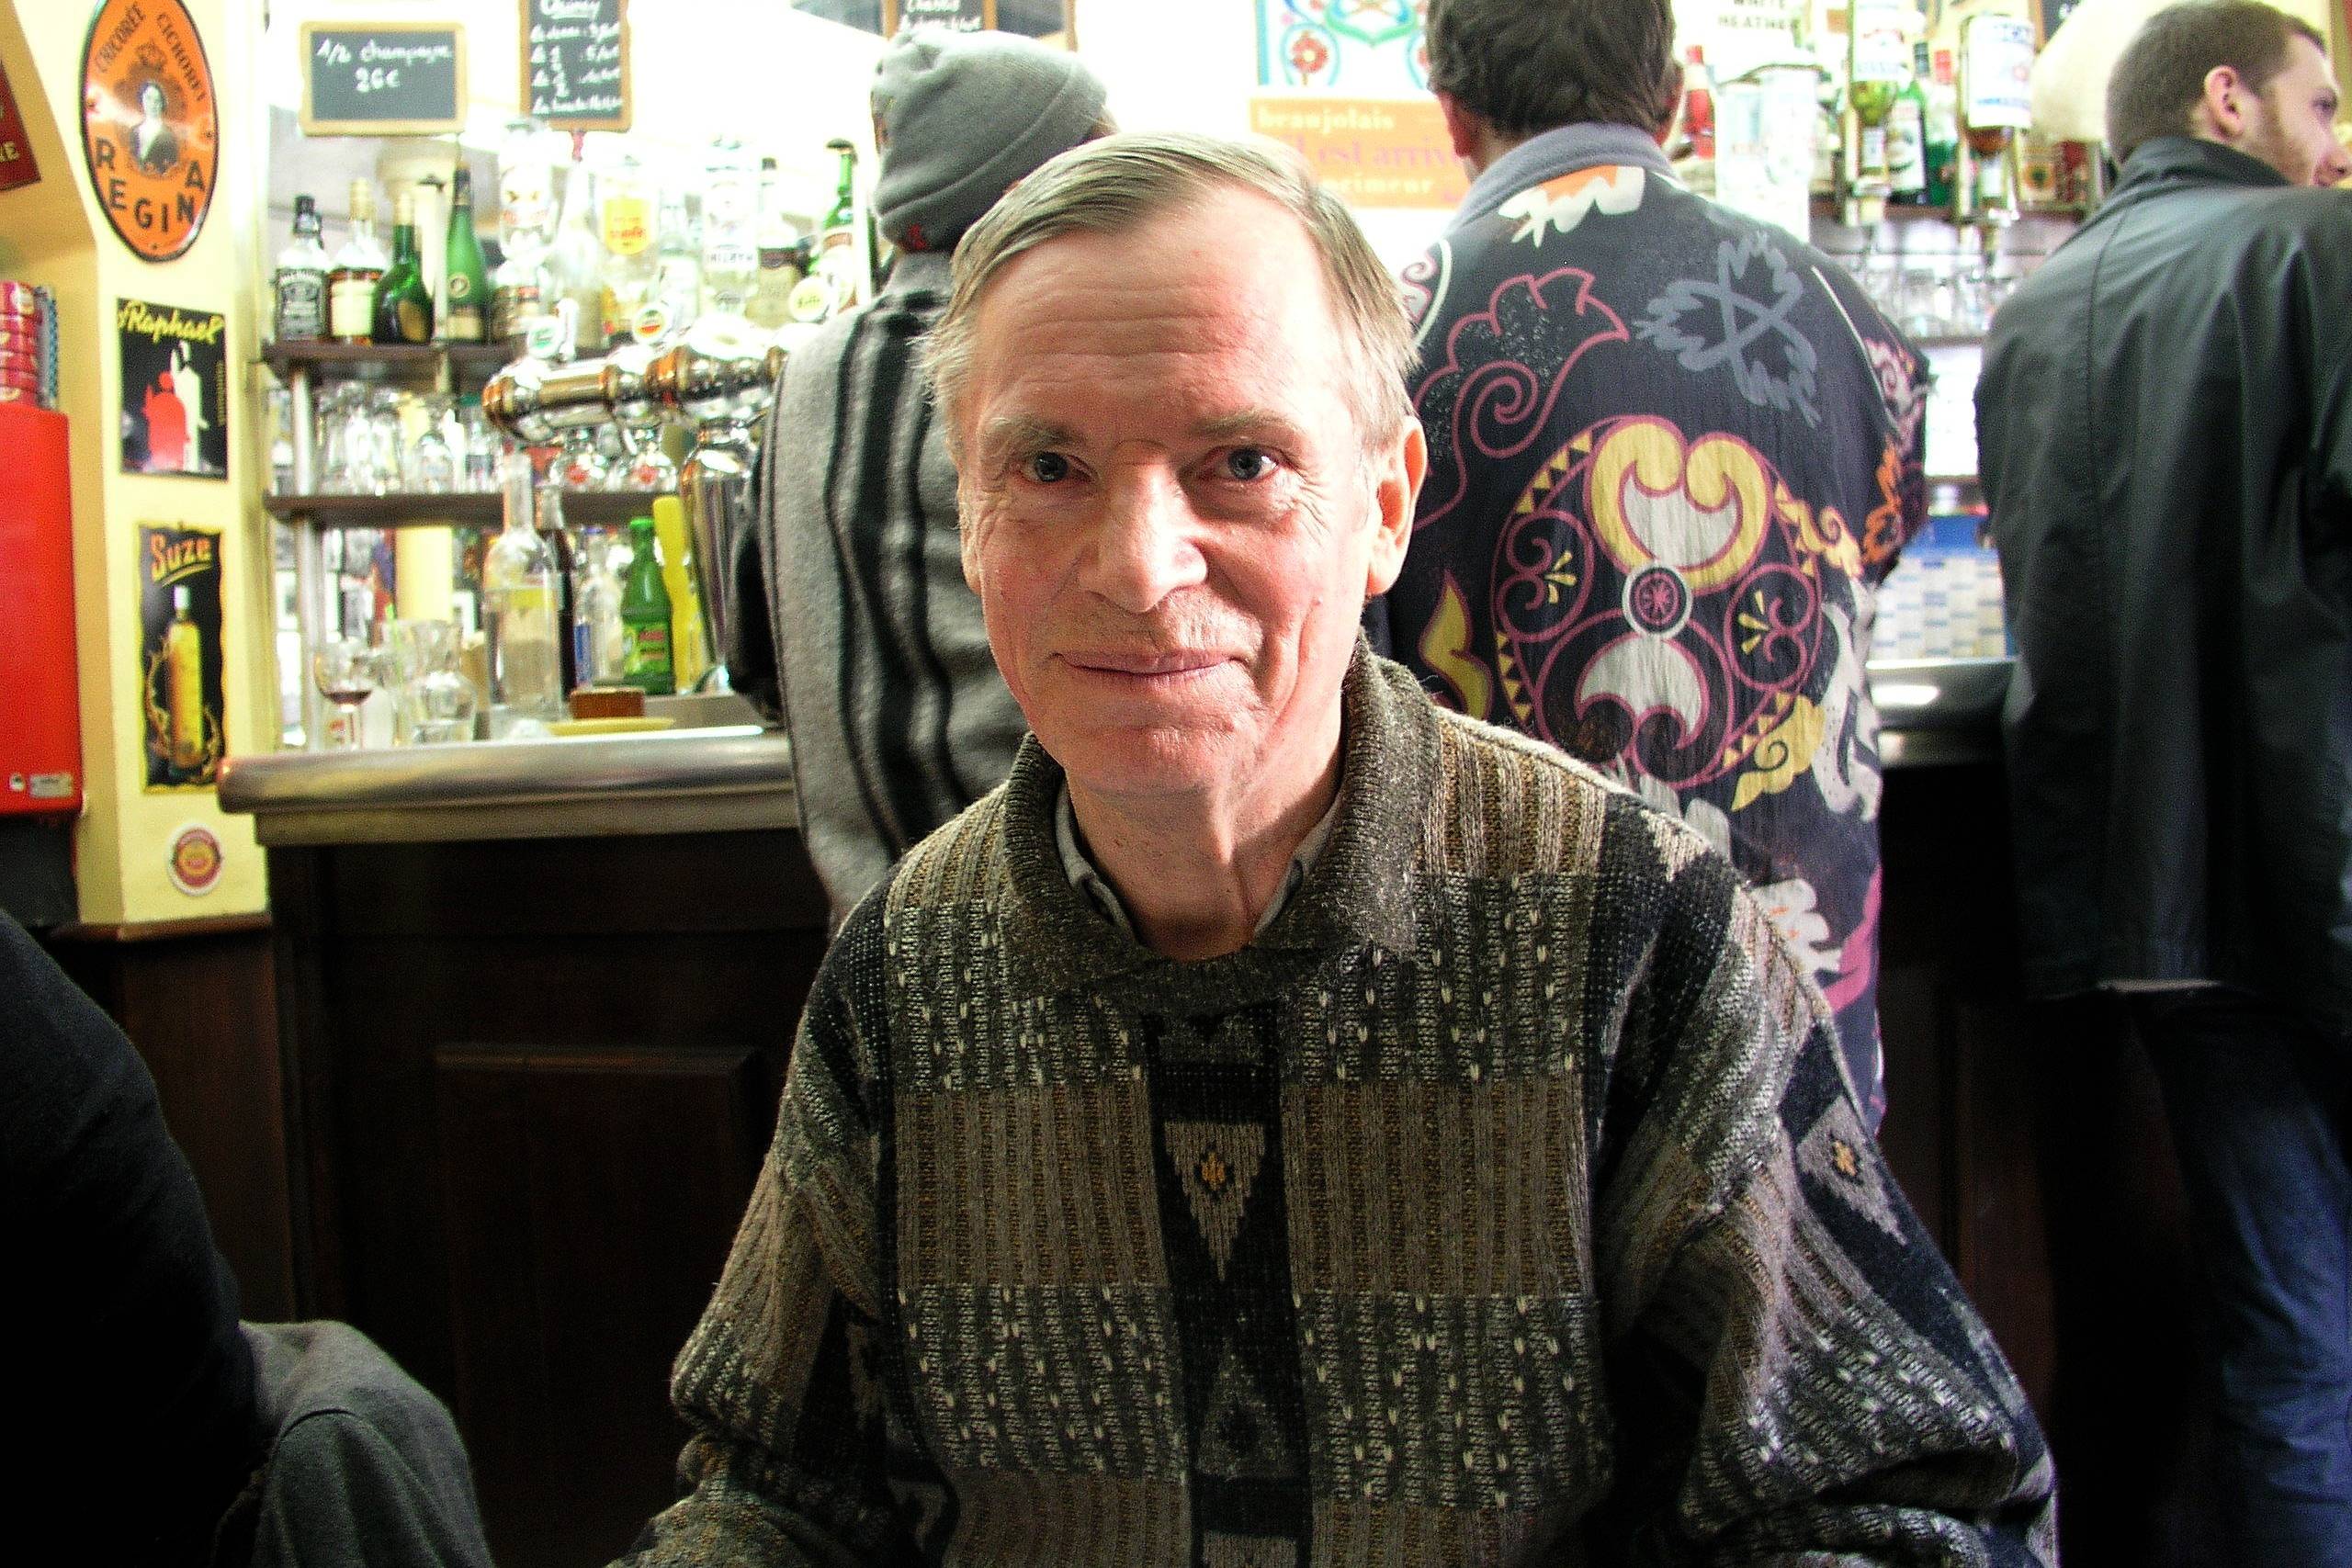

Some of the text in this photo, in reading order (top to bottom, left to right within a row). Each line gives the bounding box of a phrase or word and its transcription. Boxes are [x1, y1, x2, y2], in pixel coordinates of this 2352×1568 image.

[1717, 15, 1796, 29] HEATHE
[1258, 106, 1395, 135] beaujolais
[95, 138, 206, 232] REGINA
[150, 533, 212, 582] Suze
